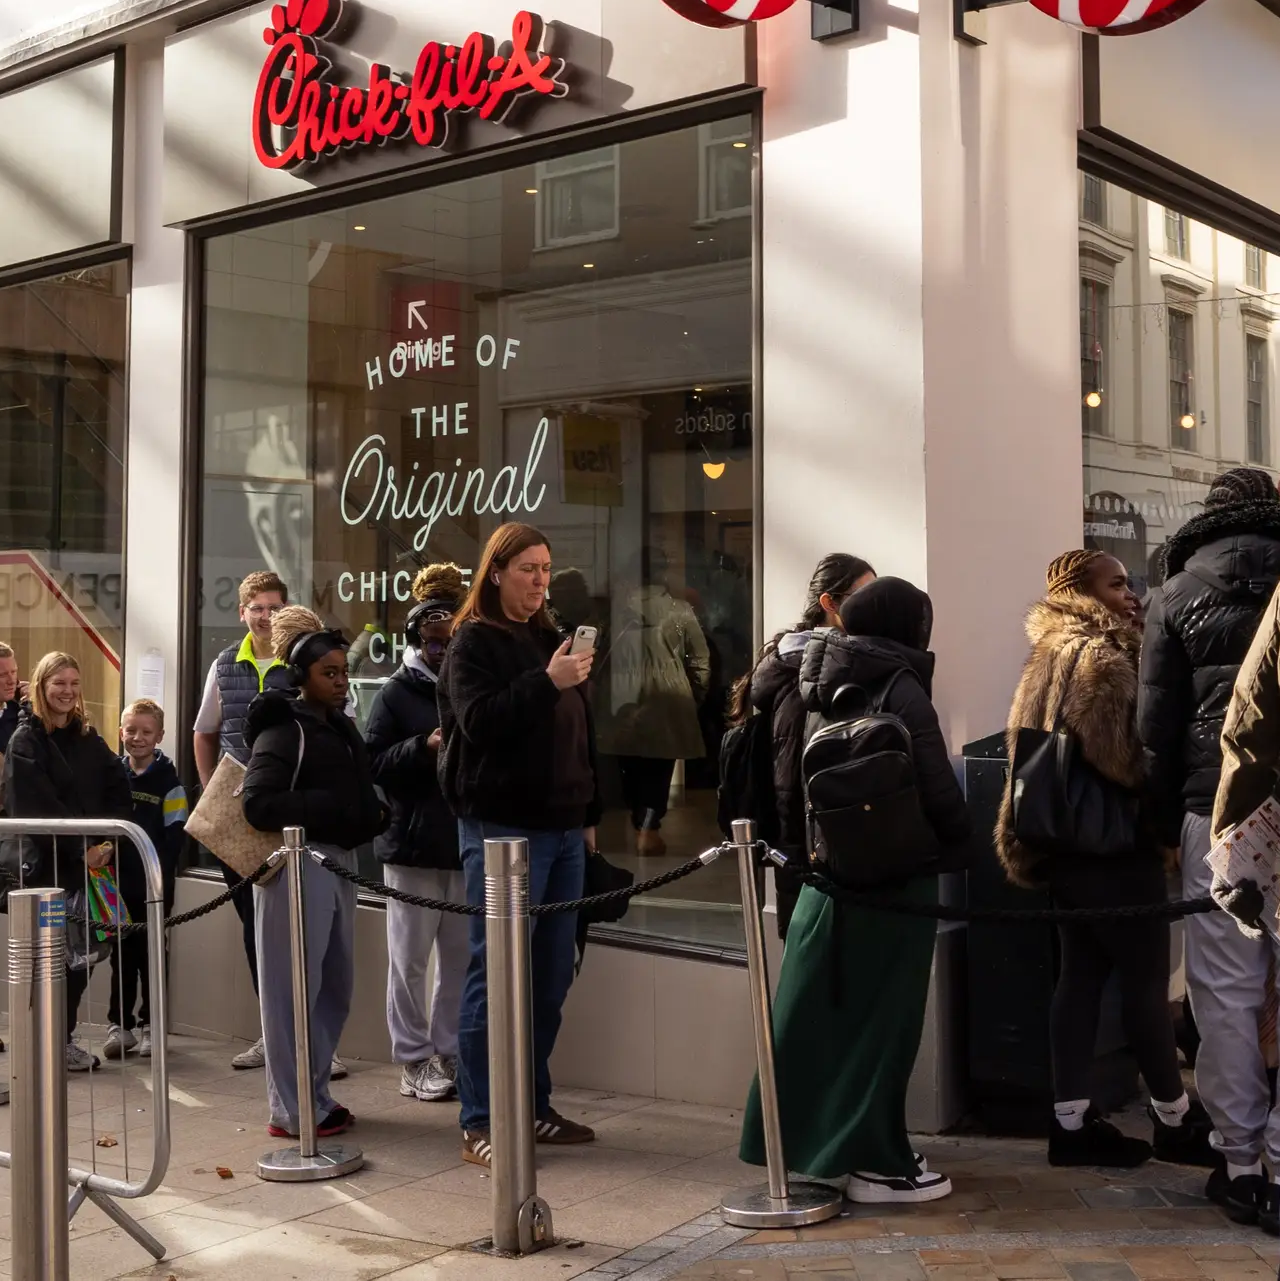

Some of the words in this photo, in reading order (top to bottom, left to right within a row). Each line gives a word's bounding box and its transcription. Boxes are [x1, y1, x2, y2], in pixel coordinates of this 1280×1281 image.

[365, 334, 456, 390] HOME
[476, 334, 521, 370] OF
[411, 402, 469, 438] THE
[340, 418, 549, 550] Original
